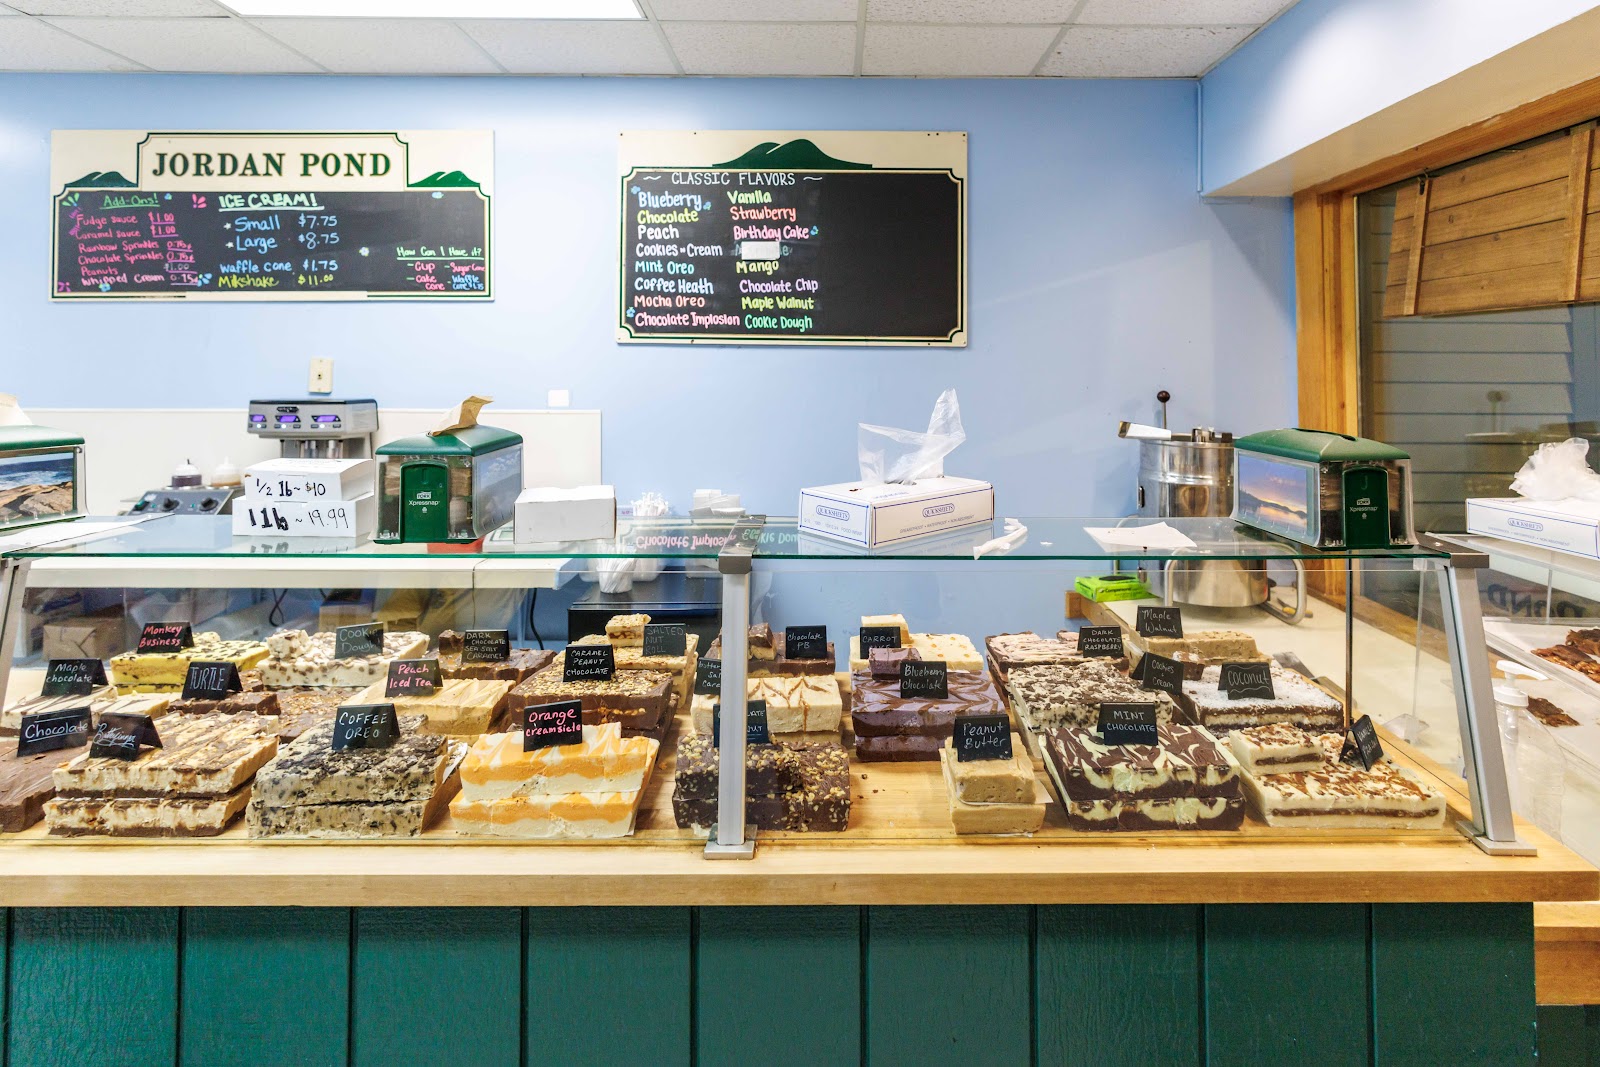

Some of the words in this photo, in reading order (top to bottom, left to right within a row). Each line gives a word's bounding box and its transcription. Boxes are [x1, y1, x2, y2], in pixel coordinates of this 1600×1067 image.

[152, 152, 285, 177] JORDAN
[300, 153, 391, 177] POND
[671, 172, 730, 185] CLASSIC
[739, 172, 796, 186] FLAVORS
[103, 193, 159, 207] Add-Ons!
[218, 194, 246, 208] ICE
[247, 193, 318, 208] CREAM!
[638, 191, 702, 211] Blueberry
[727, 190, 772, 204] Vanilla
[76, 213, 107, 230] Fudge
[148, 212, 175, 223] $1.00
[637, 208, 699, 224] Chocolate
[730, 206, 796, 222] Strawberry
[235, 214, 280, 232] Small
[298, 213, 338, 229] $7.75
[75, 229, 113, 240] Caramel
[150, 225, 176, 236] $1.00
[637, 225, 679, 240] Peach
[733, 225, 781, 242] Birthday
[783, 226, 809, 239] Cake
[78, 243, 118, 253] Rainbow
[122, 240, 159, 253] Sprinkles
[236, 236, 278, 254] Large
[298, 232, 339, 249] $8.75
[636, 243, 679, 257] Cookies
[687, 243, 723, 257] Cream
[78, 254, 122, 265] Chocolate
[124, 251, 164, 264] Sprinkles
[396, 246, 416, 257] How
[420, 246, 436, 257] Can
[440, 246, 445, 256] I
[448, 247, 468, 257] Have
[81, 266, 119, 276] Peanuts
[263, 261, 292, 273] cone
[302, 259, 338, 272] $1.75
[450, 262, 472, 276] Sugar
[635, 261, 664, 273] Mint
[667, 261, 694, 274] Oreo
[736, 261, 779, 275] Mango
[134, 273, 165, 283] Cream
[218, 274, 279, 288] Milkshake
[298, 274, 334, 285] $11.00
[452, 274, 480, 283] Waffle
[634, 277, 676, 292] Coffee
[678, 278, 714, 295] Heath
[739, 279, 792, 293] Chocolate
[795, 278, 819, 294] Chip
[634, 295, 672, 308] Mocha
[676, 295, 705, 307] Oreo
[741, 296, 774, 311] Maple
[775, 296, 815, 310] Walnut
[635, 312, 689, 327] Chocolate
[691, 311, 740, 329] Implosion
[744, 315, 777, 329] Cookie
[780, 316, 813, 332] Dough
[305, 481, 326, 497] $10
[308, 508, 349, 529] 19.99
[1142, 609, 1171, 621] Maple
[143, 625, 182, 638] Monkey
[645, 626, 684, 636] SALTED
[1145, 622, 1177, 634] Walnut
[138, 637, 181, 648] Business
[645, 636, 664, 644] NUT
[862, 635, 897, 643] CARROT
[571, 649, 608, 657] CARAMEL
[645, 645, 667, 655] ROLL
[1084, 643, 1122, 651] RASPBERRY
[466, 652, 504, 660] CARAMEL
[572, 658, 603, 666] PEANUT
[55, 663, 88, 674] Maple
[397, 663, 429, 674] Peach
[566, 667, 609, 677] CHOCOLATE
[904, 663, 945, 683] Blueberry
[188, 666, 226, 691] TURTLE
[389, 677, 411, 688] Iced
[414, 677, 433, 687] Tea
[338, 712, 388, 725] COFFEE
[528, 708, 577, 725] Orange
[1113, 711, 1145, 721] MINT
[25, 721, 88, 739] Chocolate
[345, 727, 380, 740] OREO
[963, 721, 1004, 737] Peanut
[1106, 722, 1156, 732] CHOCOLATE
[964, 737, 1005, 750] Butter
